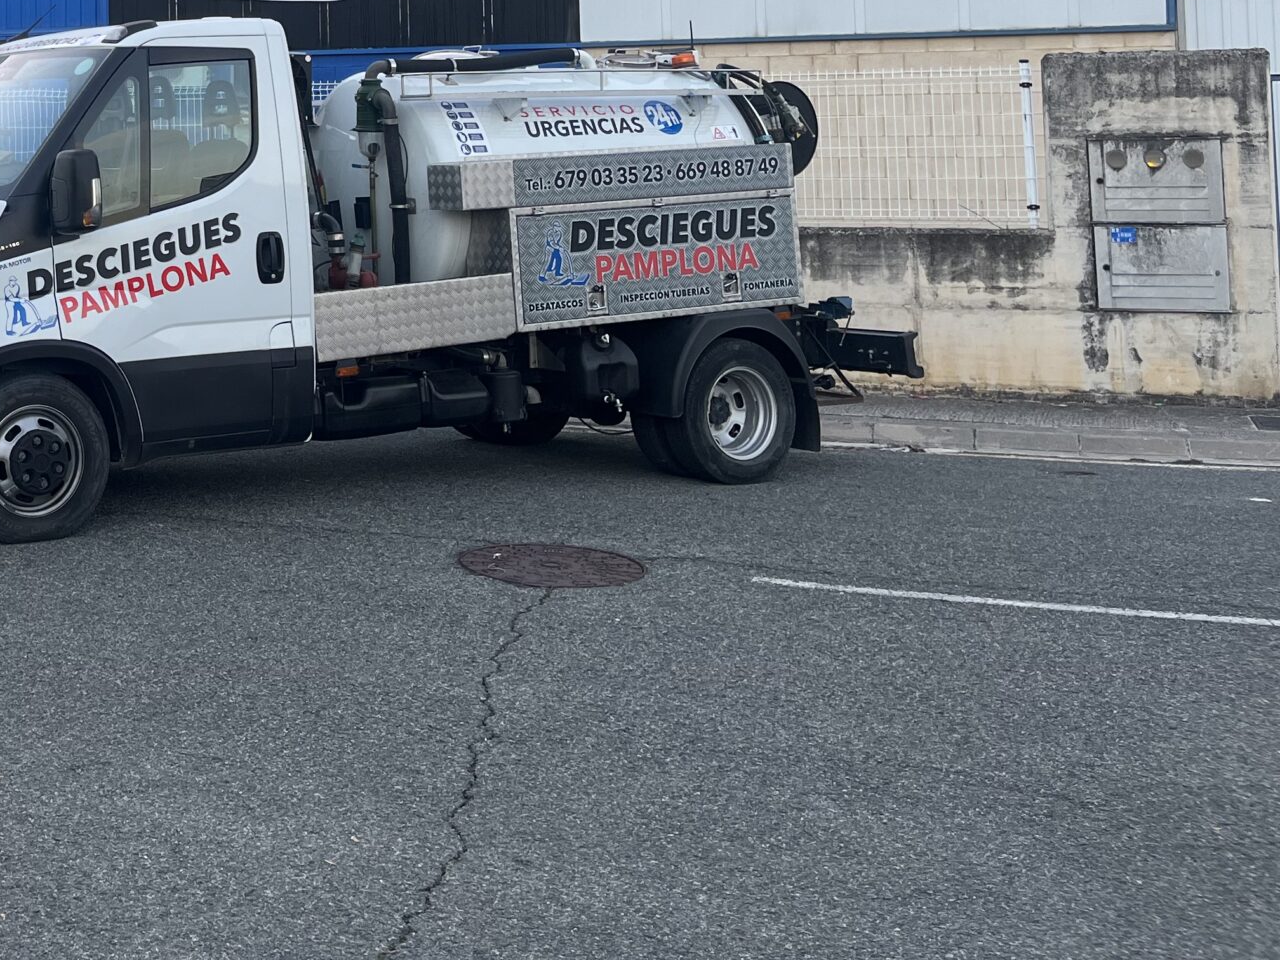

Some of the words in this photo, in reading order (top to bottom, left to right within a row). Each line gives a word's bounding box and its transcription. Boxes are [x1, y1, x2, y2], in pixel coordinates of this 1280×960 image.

[520, 104, 635, 118] SERVICIO
[524, 117, 645, 138] URGENCIAS
[647, 103, 681, 130] 24H
[525, 178, 552, 191] Tel.:
[553, 169, 588, 189] 679
[591, 167, 613, 186] 03
[617, 166, 639, 185] 35
[642, 164, 664, 183] 23
[675, 161, 707, 181] 669
[710, 160, 731, 178] 48
[734, 159, 755, 177] 87
[758, 157, 779, 175] 49
[570, 205, 776, 253] DESCIEGUES
[8, 257, 32, 268] MOTOR
[27, 212, 242, 301] DESCIEGUES
[595, 242, 759, 283] PAMPLONA
[59, 253, 231, 324] PAMPLONA
[528, 299, 584, 312] DESATASCOS
[620, 289, 670, 303] INSPECCIÓN
[671, 286, 710, 299] TUBERÍAS
[743, 277, 794, 291] FONTANERÍA
